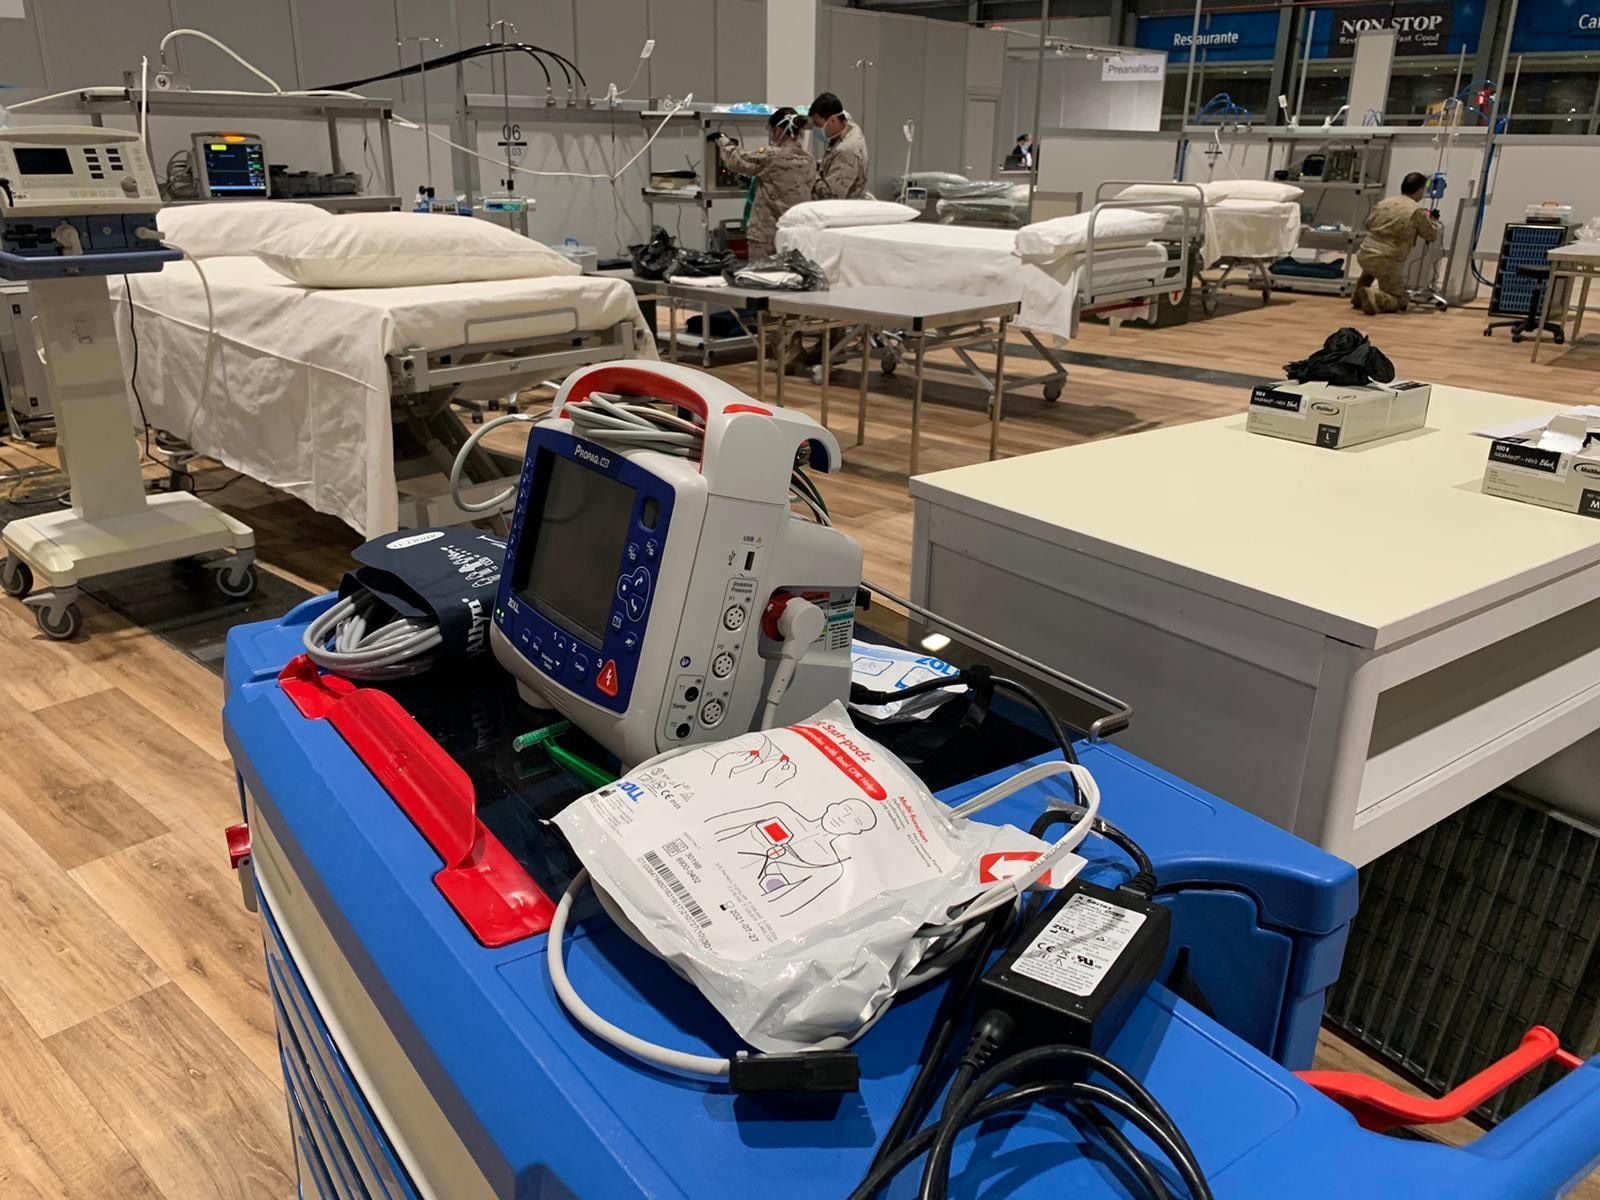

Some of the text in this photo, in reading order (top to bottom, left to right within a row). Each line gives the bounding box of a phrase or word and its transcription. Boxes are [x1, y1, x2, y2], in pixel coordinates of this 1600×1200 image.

[1391, 15, 1443, 31] STOP
[1578, 14, 1600, 29] Ca
[1173, 31, 1239, 47] Resaurante
[1415, 33, 1440, 42] Good
[1107, 64, 1160, 76] Preanalítica
[502, 124, 521, 141] 06
[553, 632, 557, 640] 1
[571, 643, 578, 653] 2
[597, 658, 603, 668] 3
[898, 796, 929, 844] Multi-function
[1052, 923, 1076, 935] ZOLL
